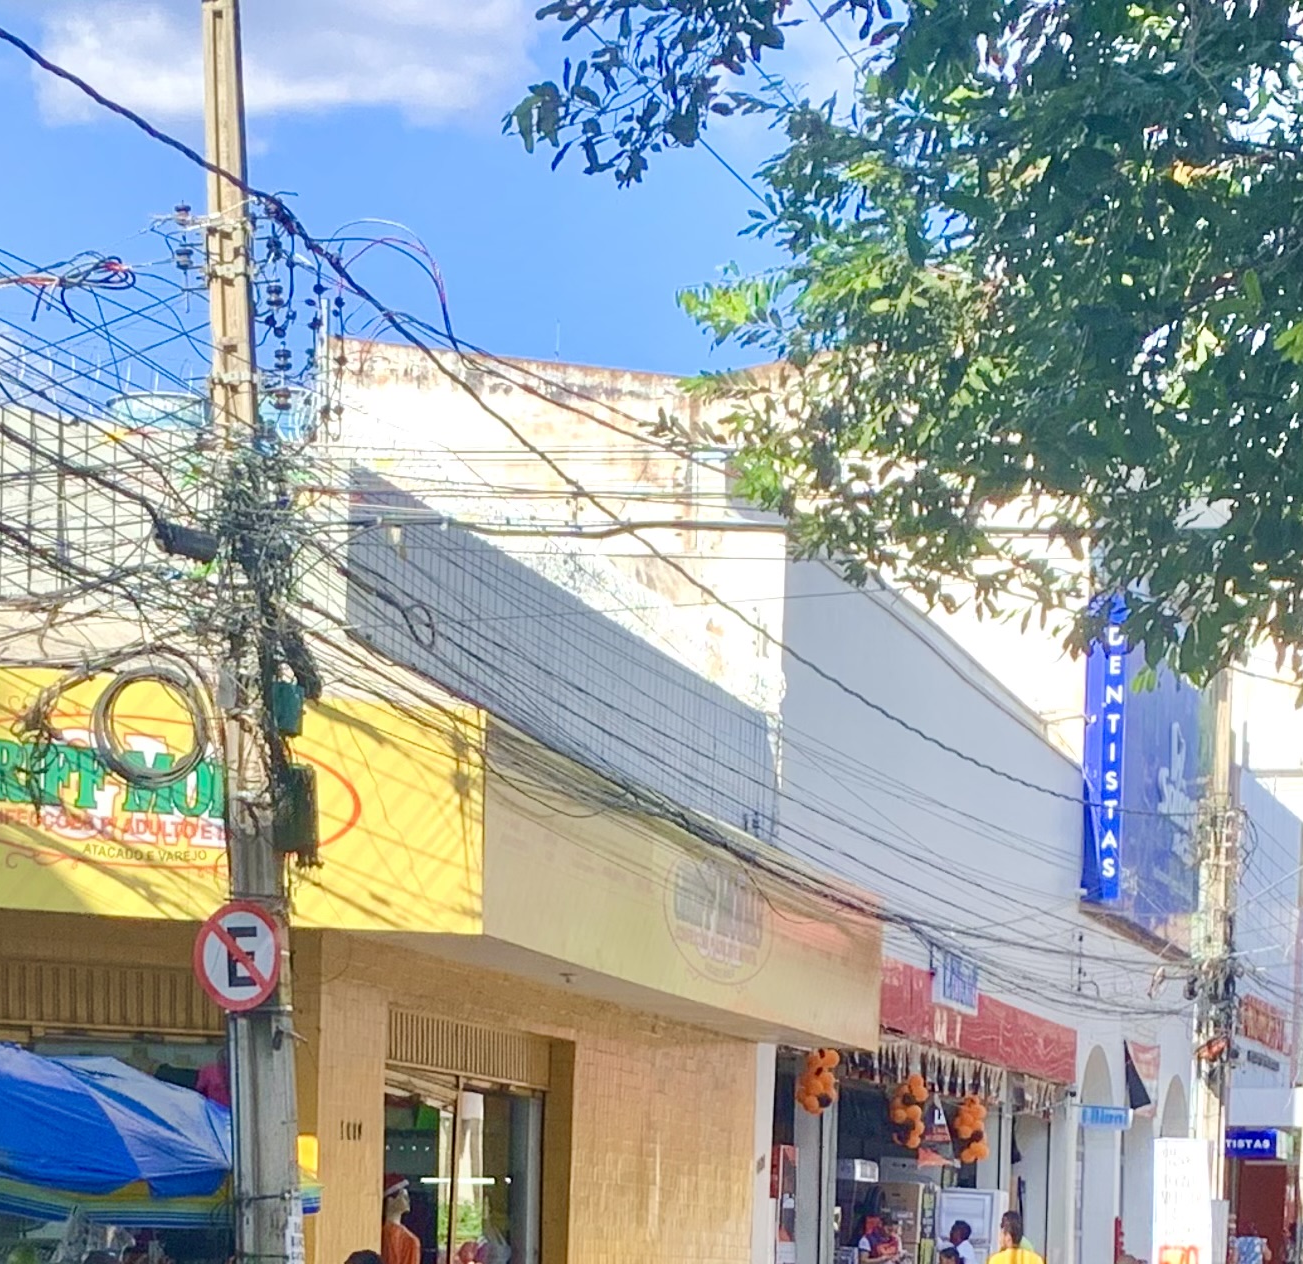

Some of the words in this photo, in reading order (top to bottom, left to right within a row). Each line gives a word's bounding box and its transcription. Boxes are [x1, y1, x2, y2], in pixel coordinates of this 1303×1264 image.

[1101, 626, 1124, 879] DENTISTAS
[123, 817, 197, 839] ADULTO
[201, 823, 213, 840] E
[83, 843, 144, 861] ATACADO
[147, 850, 154, 860] E
[158, 849, 207, 862] VAREJO
